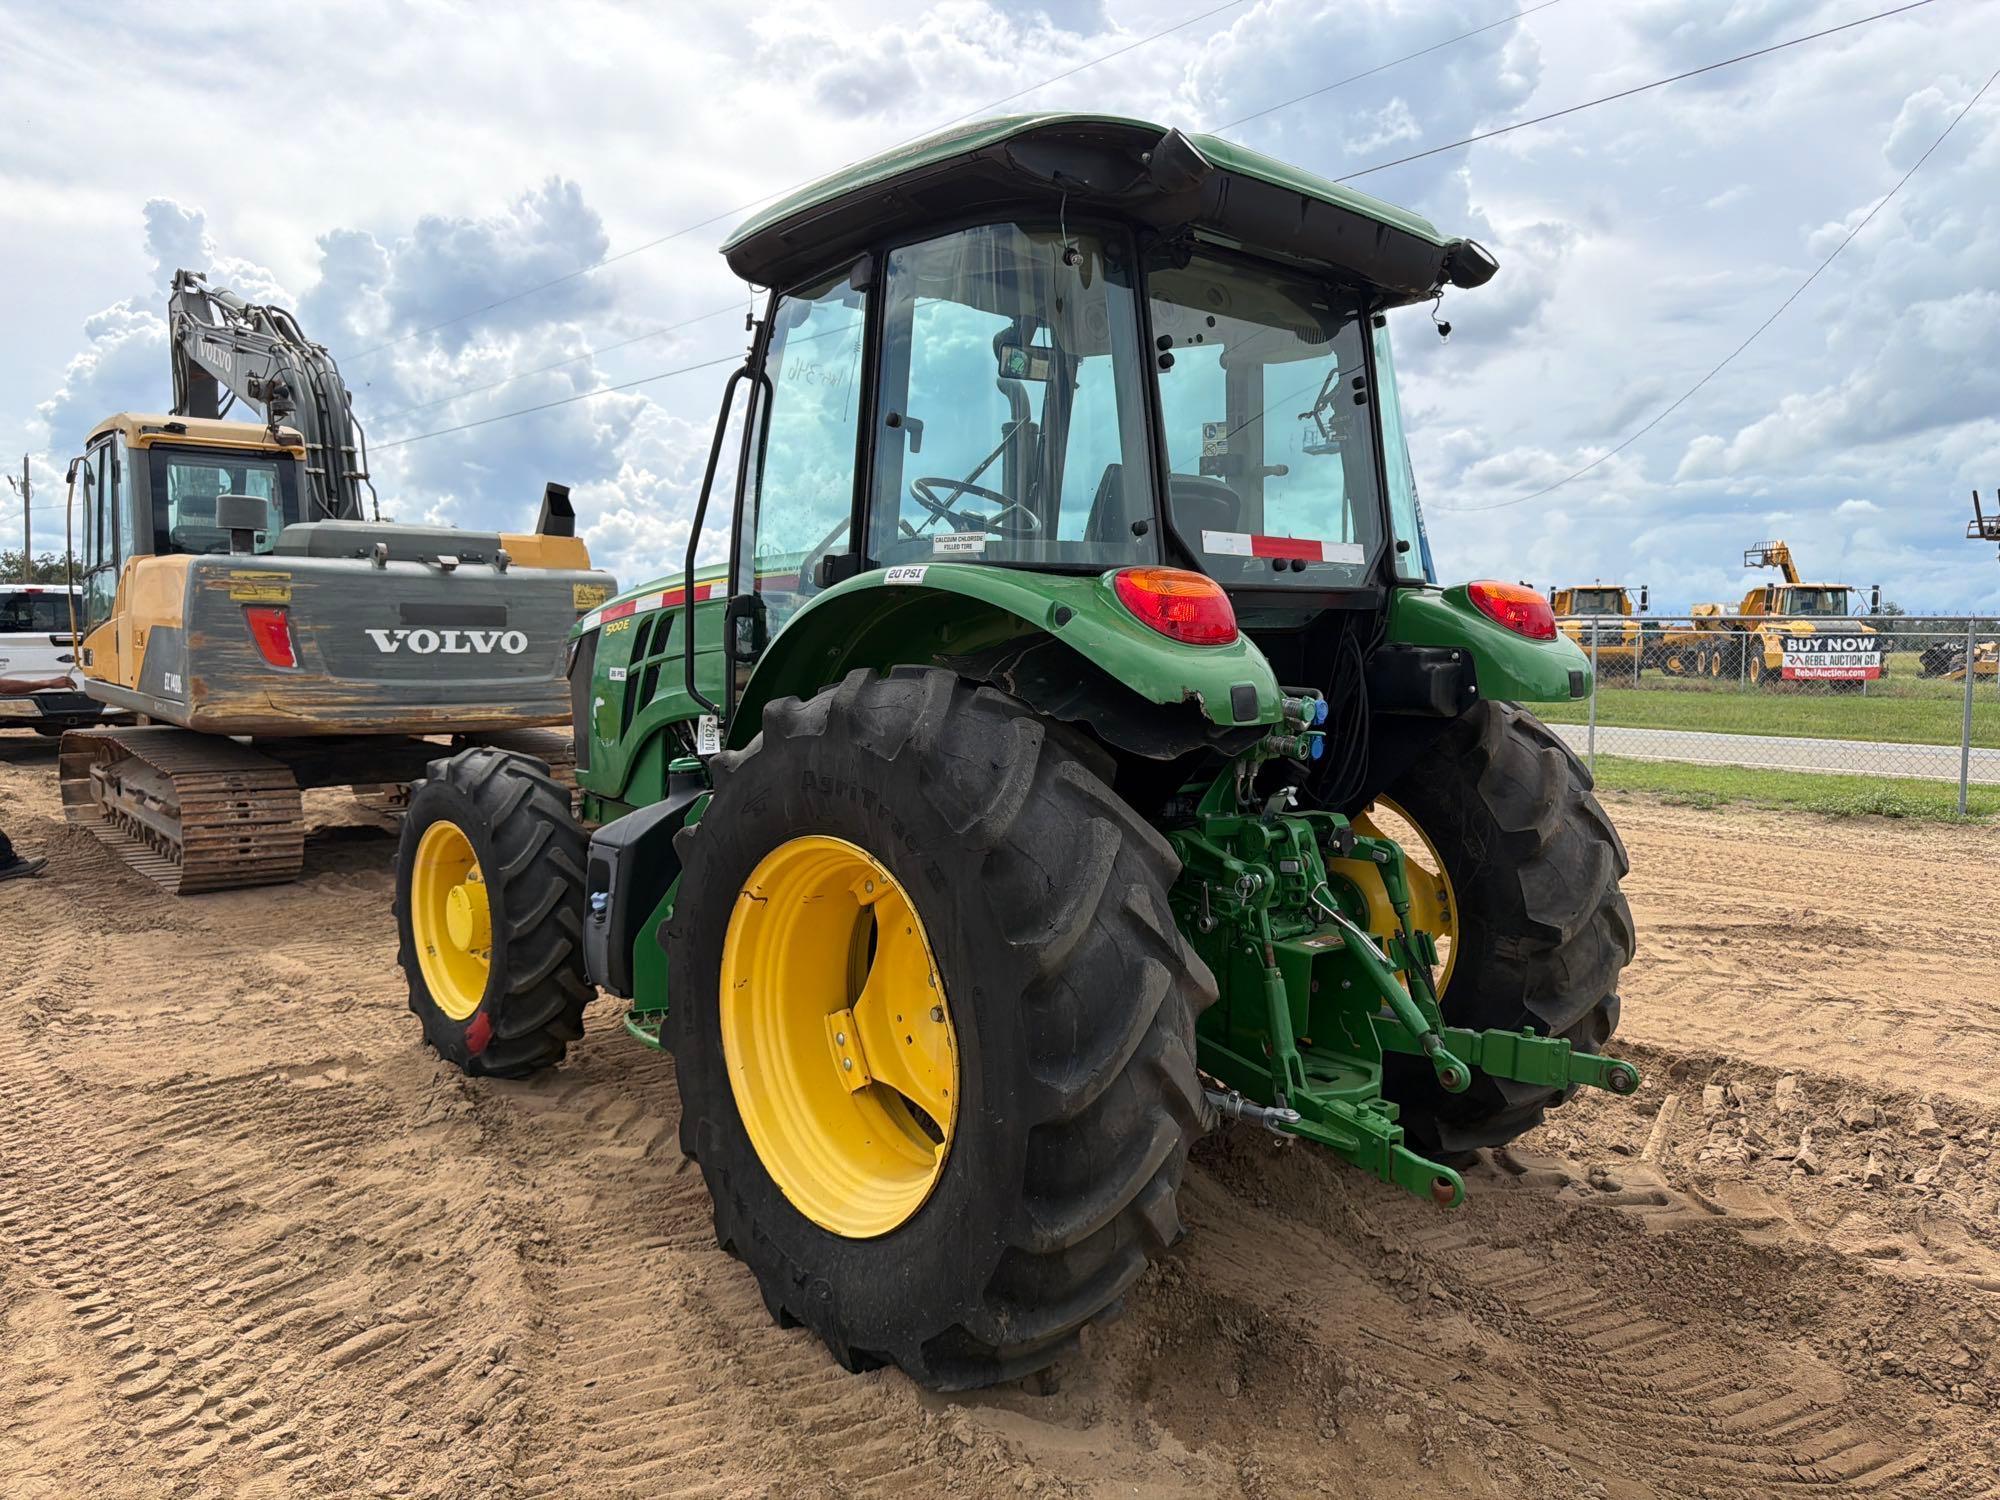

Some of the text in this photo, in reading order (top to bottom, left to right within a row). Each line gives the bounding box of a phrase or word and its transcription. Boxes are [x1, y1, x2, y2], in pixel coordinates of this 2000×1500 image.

[199, 337, 232, 372] VOLVO
[935, 534, 983, 543] CALCIUM CHLORIDE
[888, 568, 923, 579] 20 PSI
[364, 629, 529, 654] VOLVO
[1787, 638, 1875, 652] BUY NOW
[1804, 654, 1878, 666] REBEL AUCTION CO.
[1794, 668, 1866, 678] RebelAuction.com
[705, 723, 716, 751] 226170
